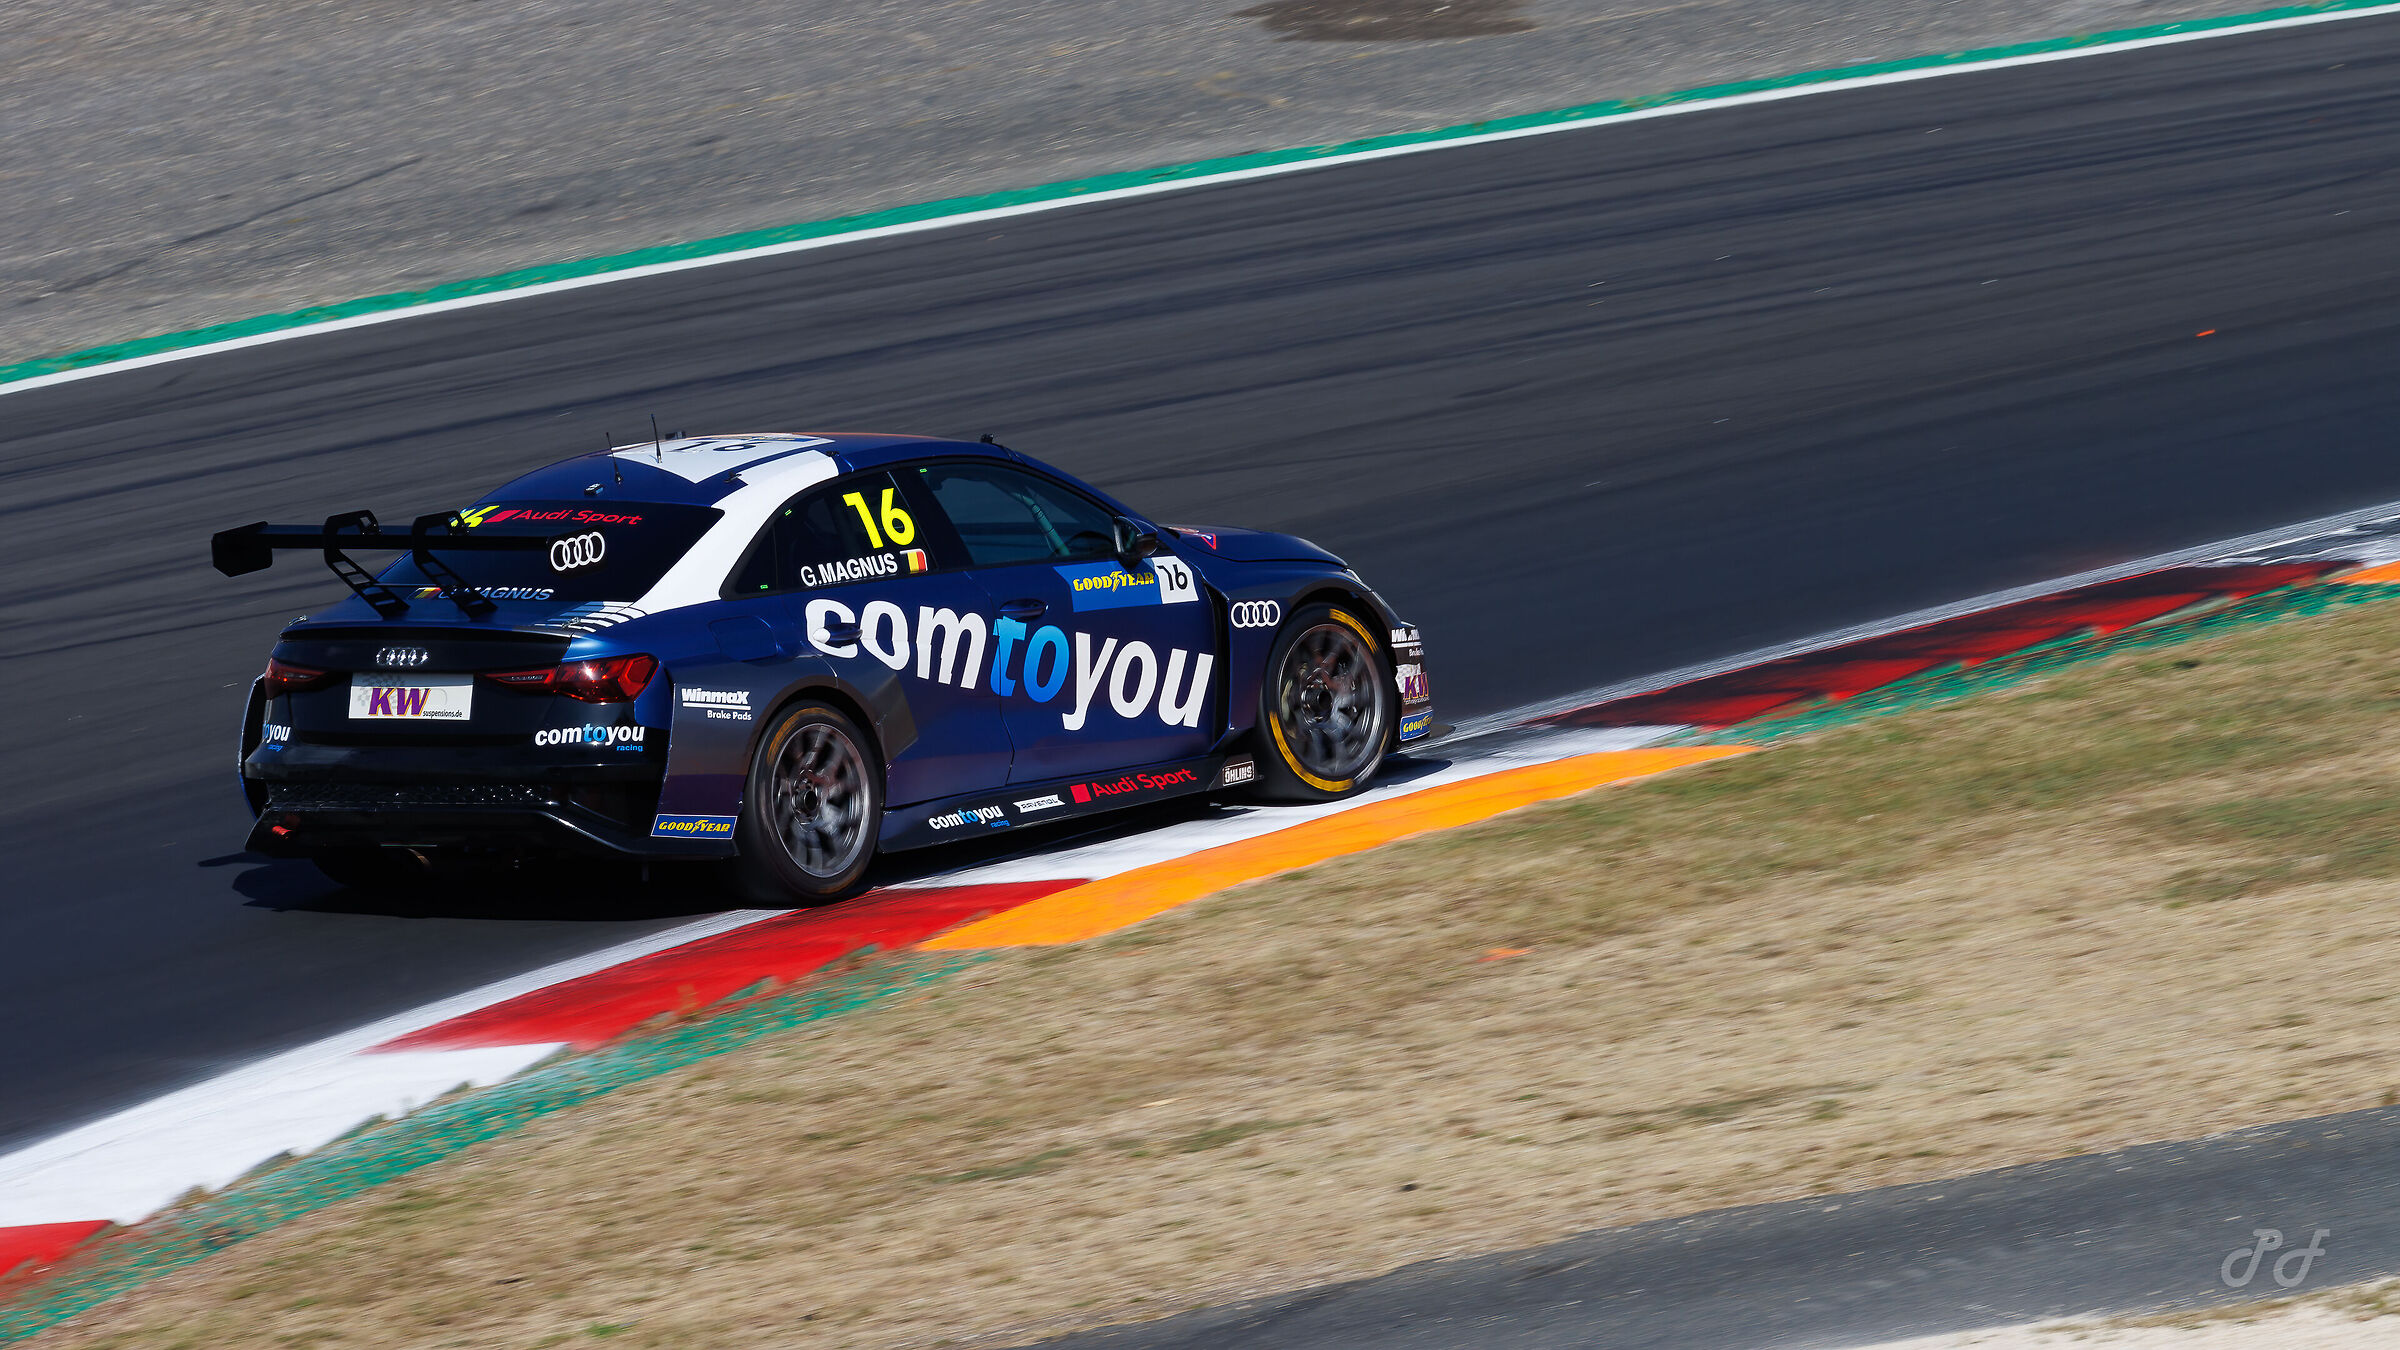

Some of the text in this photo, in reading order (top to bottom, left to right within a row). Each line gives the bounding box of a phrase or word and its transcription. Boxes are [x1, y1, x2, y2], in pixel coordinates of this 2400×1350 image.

[512, 510, 643, 525] Audi Sport
[842, 488, 915, 549] 16
[800, 552, 898, 587] G.MAGNUS
[1156, 564, 1189, 591] 16
[1073, 571, 1155, 593] GOODYEAR
[805, 598, 1214, 731] comtoyou
[368, 687, 432, 716] KW
[422, 709, 463, 719] suspensions.de
[707, 710, 752, 721] Brake Pads
[535, 723, 645, 746] comtoyou
[616, 744, 643, 752] racing
[1091, 768, 1198, 798] Audi Sport
[658, 820, 731, 834] GOODYEAR
[928, 805, 1004, 830] comtoyou
[990, 819, 1010, 828] racing
